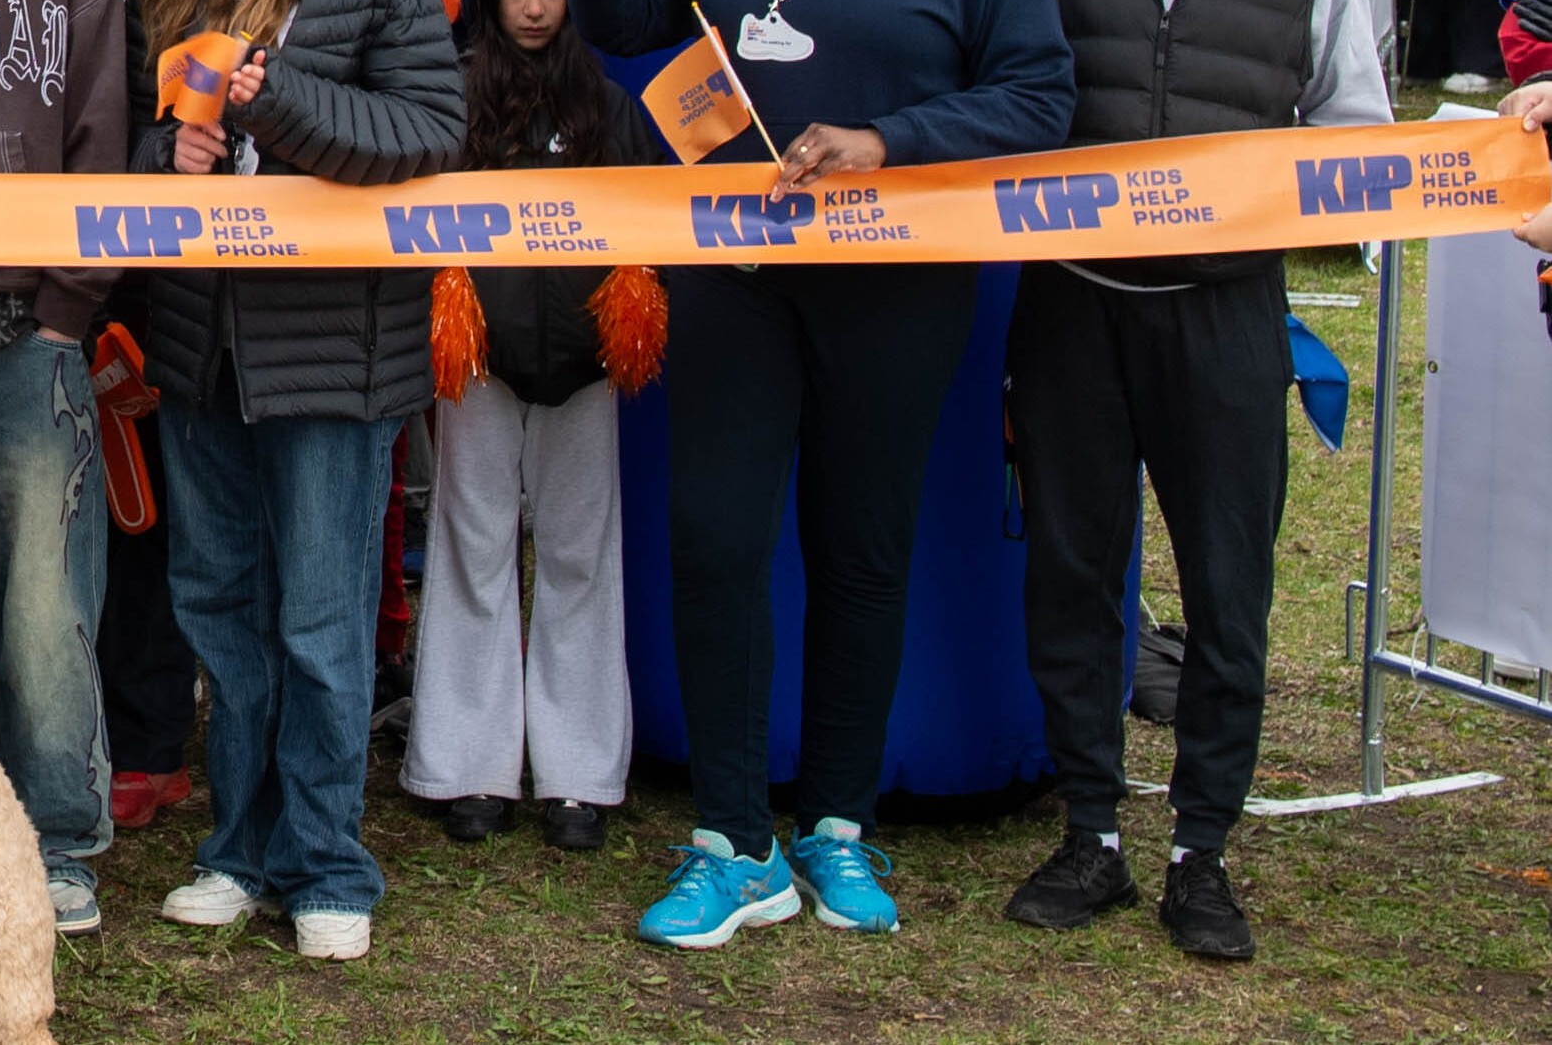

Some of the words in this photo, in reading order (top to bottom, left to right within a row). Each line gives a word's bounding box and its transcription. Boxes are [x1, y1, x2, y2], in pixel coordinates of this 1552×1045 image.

[1296, 155, 1413, 216] KHP
[1418, 151, 1472, 170] KIDS
[1420, 171, 1479, 190] HELP
[995, 173, 1119, 233] KHP
[1126, 169, 1182, 188] KIDS
[1129, 188, 1191, 207] HELP
[1423, 190, 1499, 210] PHONE
[691, 193, 816, 248] KHP
[824, 189, 879, 207] KIDS
[824, 209, 884, 226] HELP
[1133, 207, 1216, 226] PHONE
[75, 205, 203, 258] KHP
[209, 207, 267, 222] KIDS
[212, 226, 275, 241] HELP
[384, 203, 512, 254] KHP
[518, 202, 576, 217] KIDS
[521, 221, 583, 237] HELP
[828, 227, 912, 244] PHONE
[216, 243, 300, 256] PHONE
[526, 239, 608, 252] PHONE
